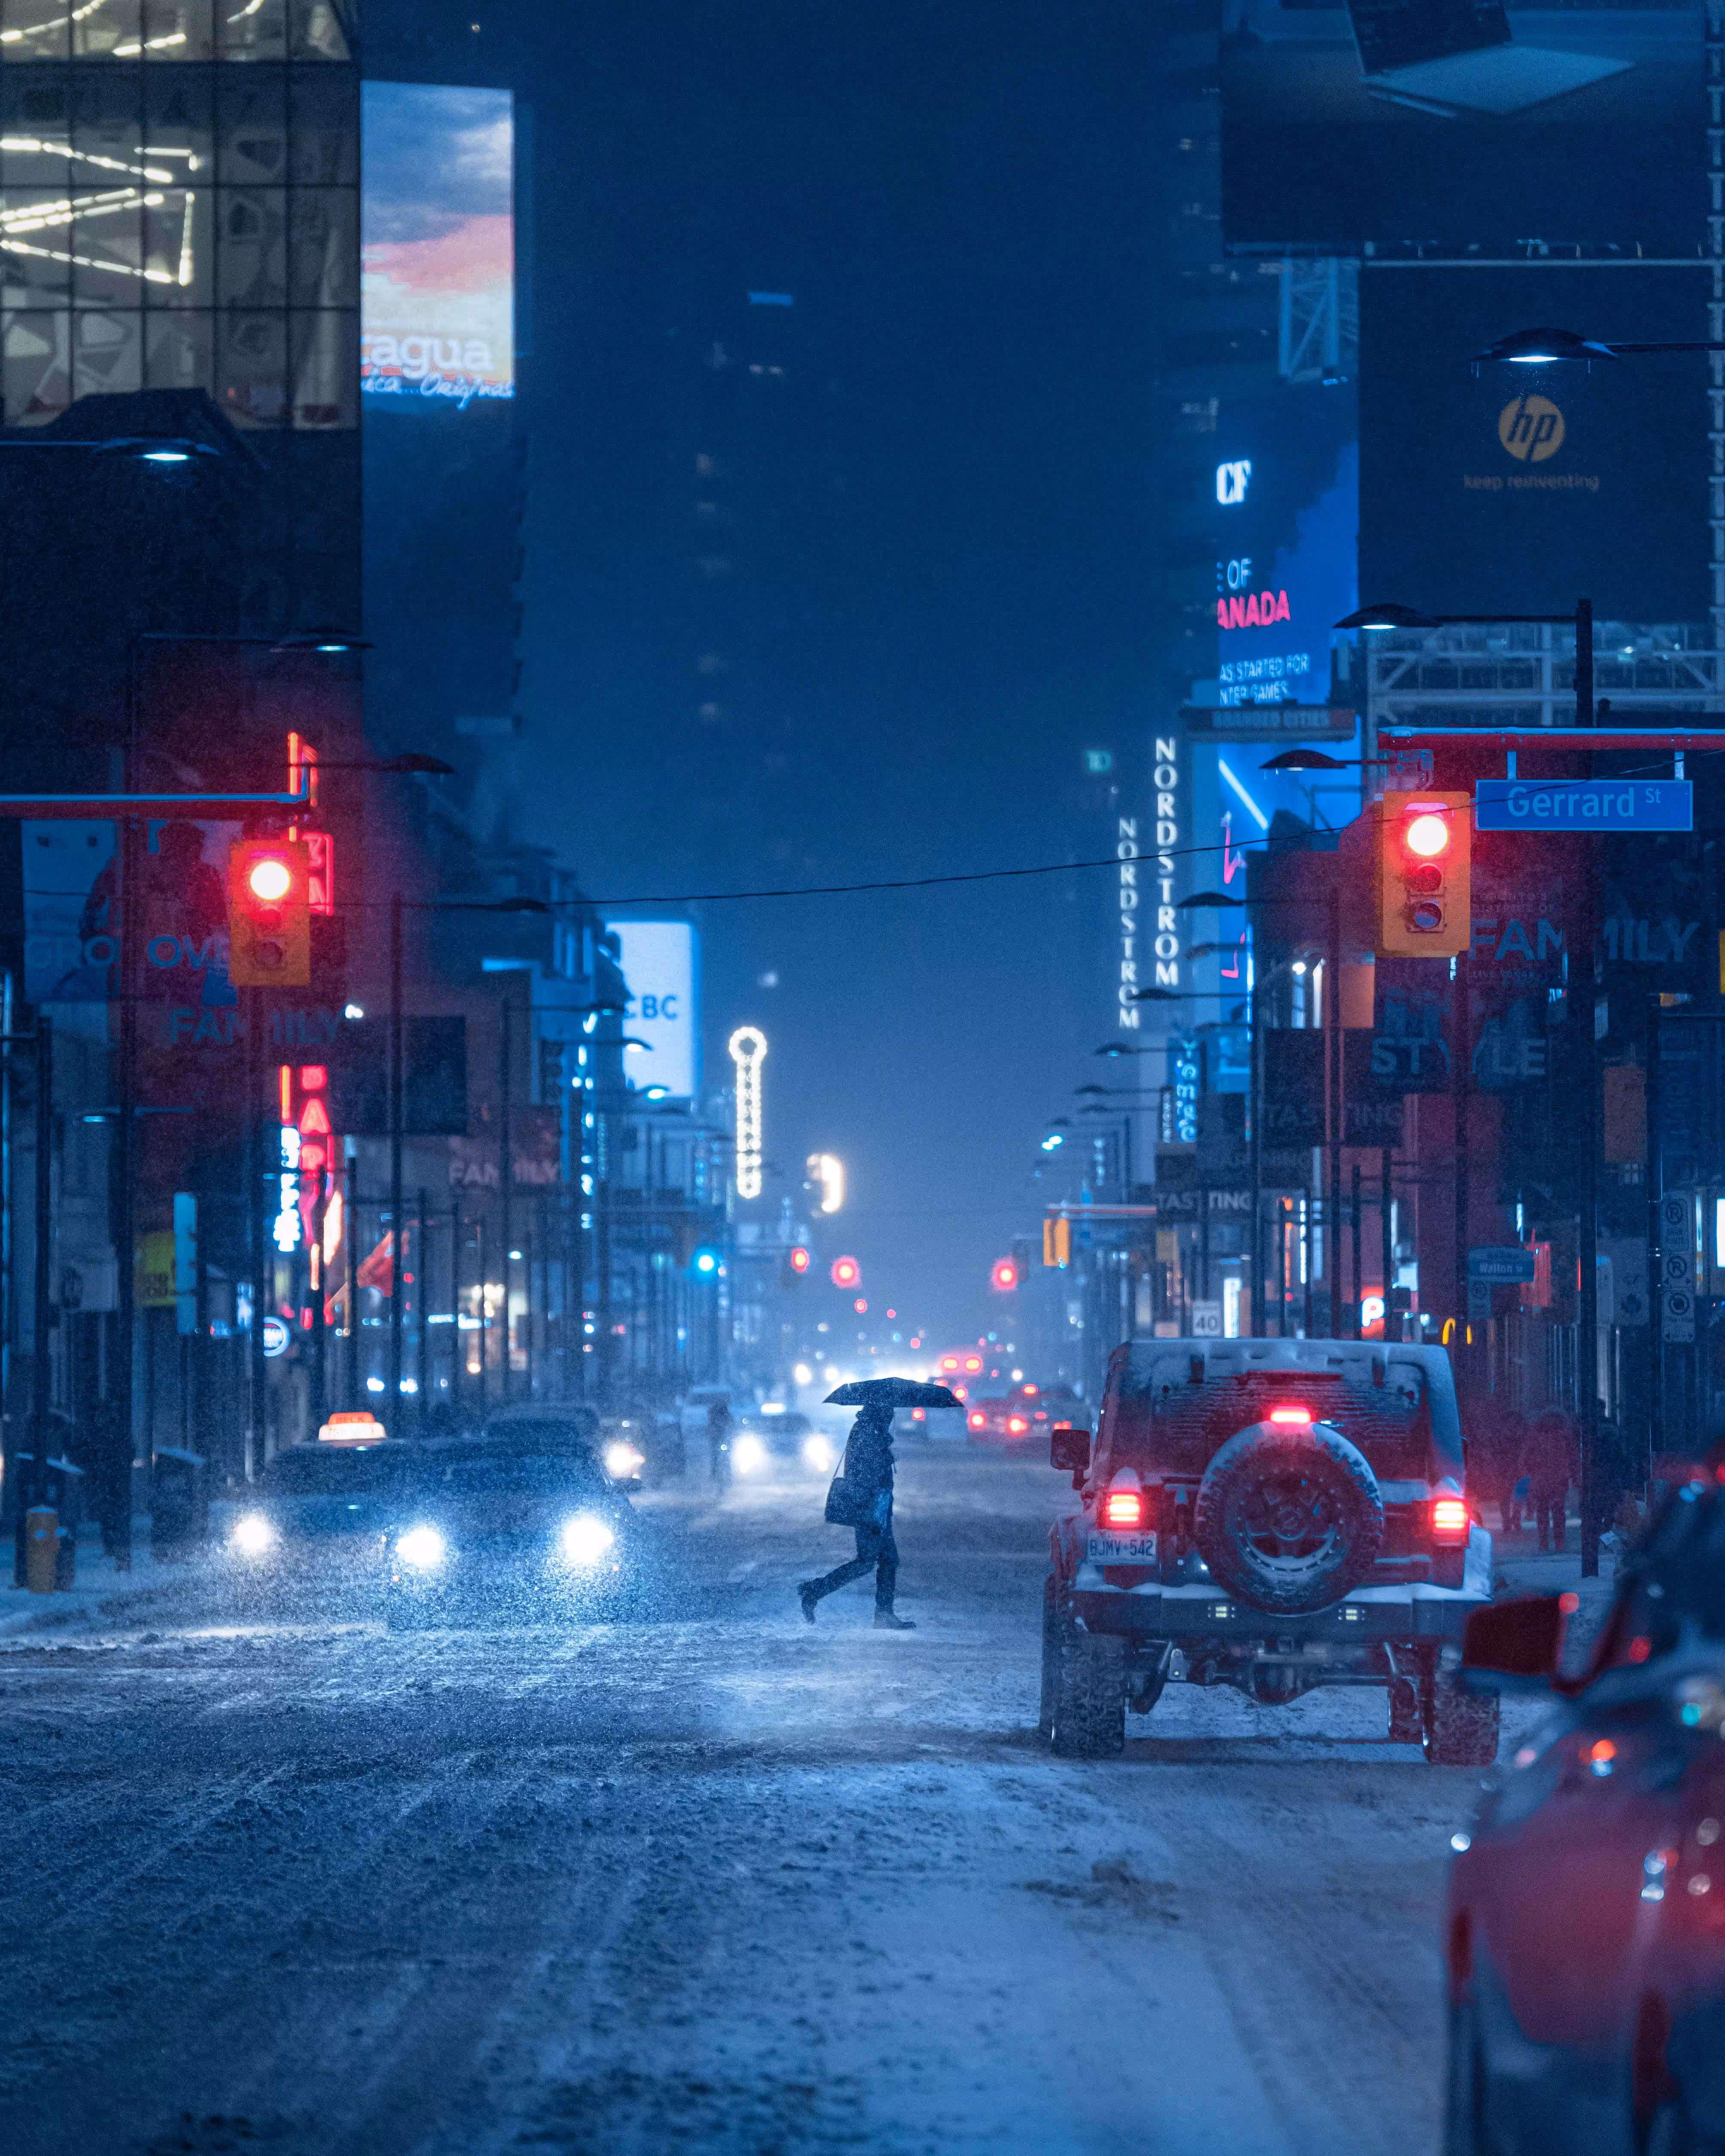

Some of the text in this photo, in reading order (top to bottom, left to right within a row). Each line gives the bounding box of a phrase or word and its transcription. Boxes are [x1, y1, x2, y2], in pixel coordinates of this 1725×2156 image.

[1503, 396, 1562, 461] hp
[1227, 558, 1252, 590] OF
[1237, 657, 1283, 682] STARTED
[1286, 653, 1310, 675] FOR
[1508, 787, 1661, 818] Gerrard St
[1154, 737, 1179, 987] NORDSTROM
[1117, 817, 1140, 1029] NORDSTROM
[1195, 1315, 1218, 1332] 40
[1130, 1540, 1153, 1556] 542
